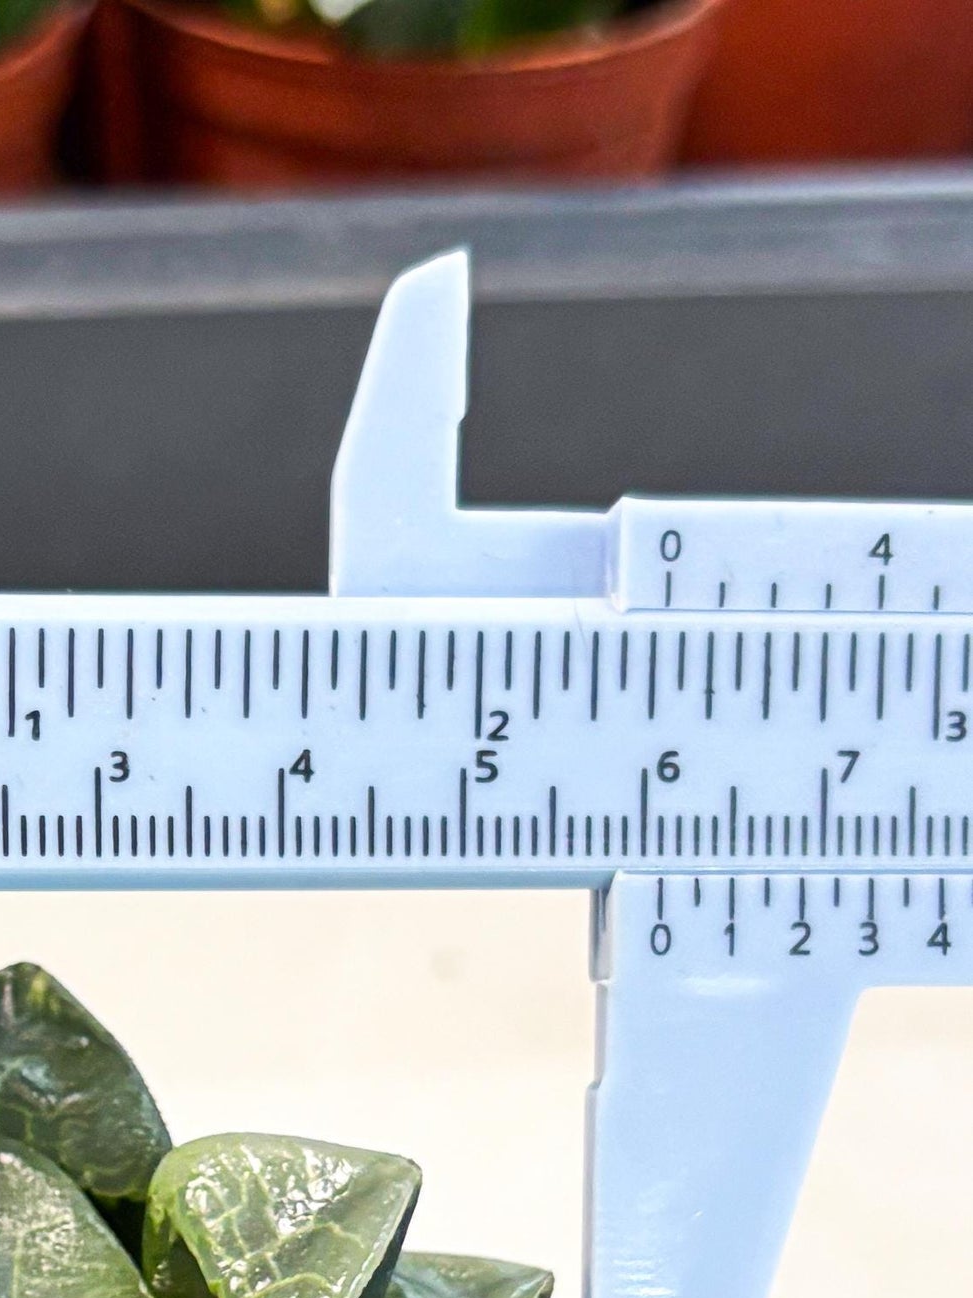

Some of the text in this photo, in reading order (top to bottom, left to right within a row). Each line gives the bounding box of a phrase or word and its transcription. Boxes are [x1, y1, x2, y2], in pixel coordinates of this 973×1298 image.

[659, 529, 894, 566] 0 4
[24, 709, 41, 742] 1
[486, 709, 510, 742] 2
[945, 710, 968, 743] 3
[108, 750, 131, 783] 3
[288, 748, 315, 784] 4
[474, 749, 499, 784] 5
[656, 750, 681, 784] 6
[837, 749, 861, 784] 7
[649, 923, 952, 957] 0 1 2 3 4
